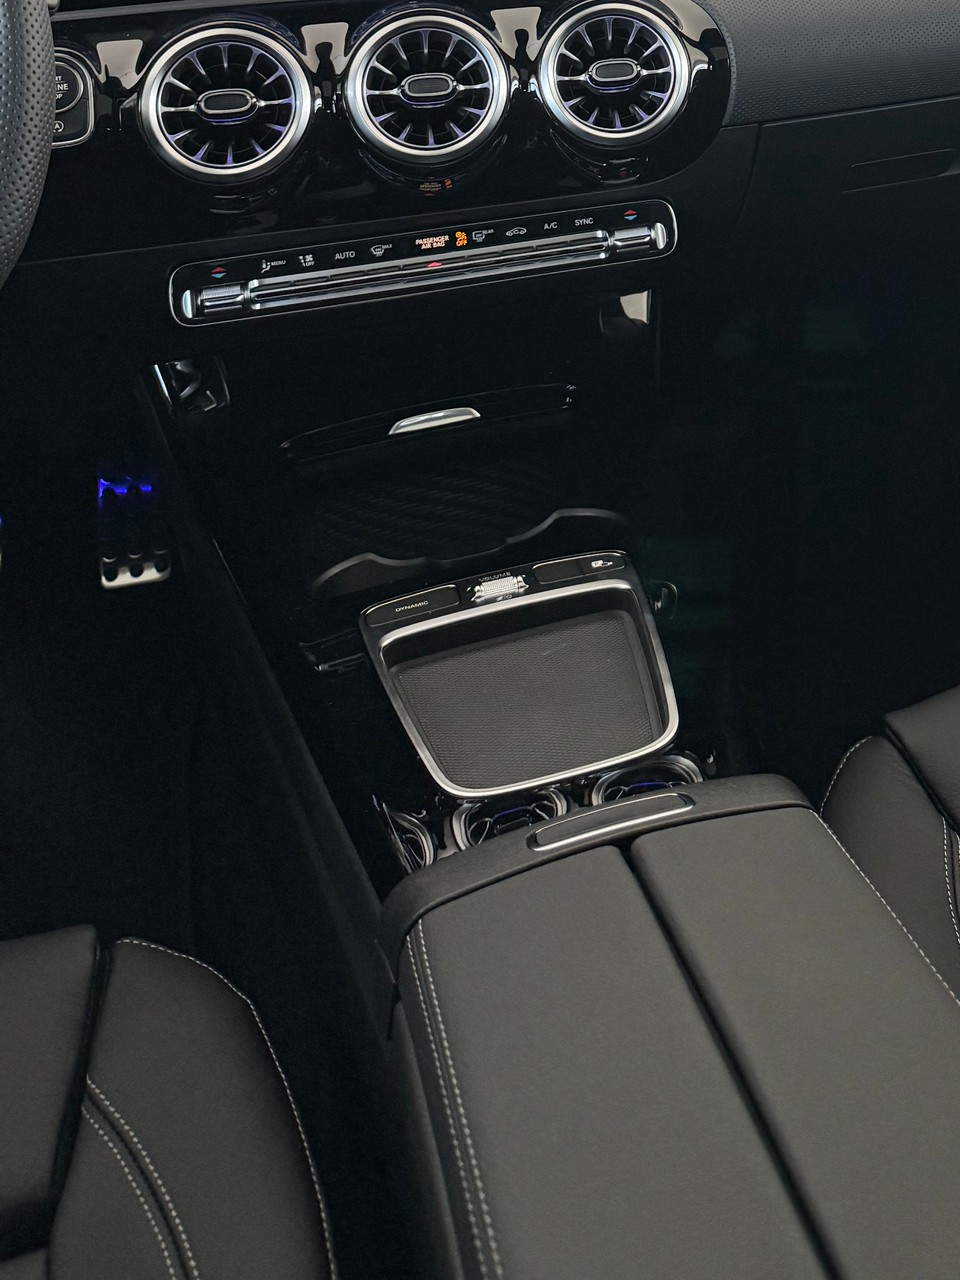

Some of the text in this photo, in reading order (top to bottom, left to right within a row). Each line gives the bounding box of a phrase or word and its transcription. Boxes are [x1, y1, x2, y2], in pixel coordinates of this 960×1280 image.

[543, 221, 558, 230] A/C
[574, 218, 594, 226] SYNC
[415, 234, 450, 245] PASSENGER
[456, 239, 468, 247] OFF
[421, 242, 432, 250] AIR
[334, 250, 356, 260] AUTO
[478, 571, 512, 582] VOLUME
[395, 600, 429, 612] DYNAMIC
